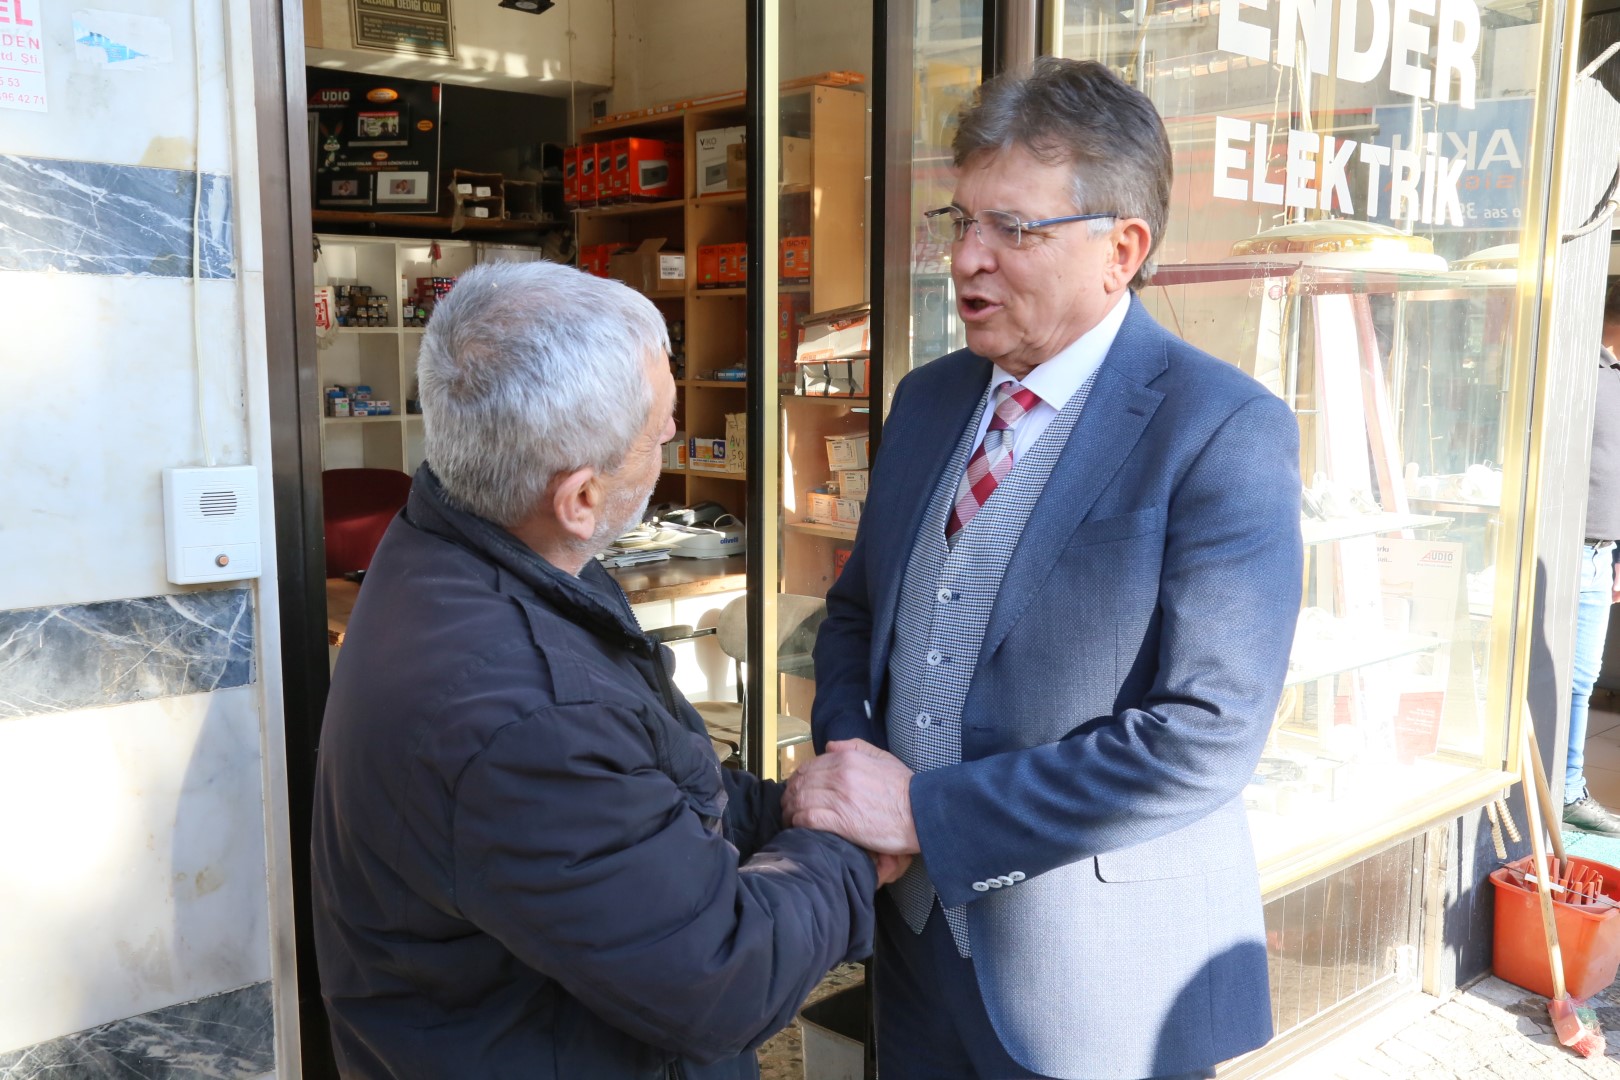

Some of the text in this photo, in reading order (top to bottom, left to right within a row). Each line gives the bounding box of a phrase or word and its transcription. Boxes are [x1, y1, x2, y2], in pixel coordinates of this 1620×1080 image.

[423, 1, 442, 14] OLUR
[1217, 0, 1481, 110] ENDER
[7, 77, 20, 88] 53
[18, 93, 31, 105] 42
[33, 95, 46, 106] 71
[1213, 115, 1467, 227] ELEKTRİK
[1422, 552, 1454, 562] AUDIO
